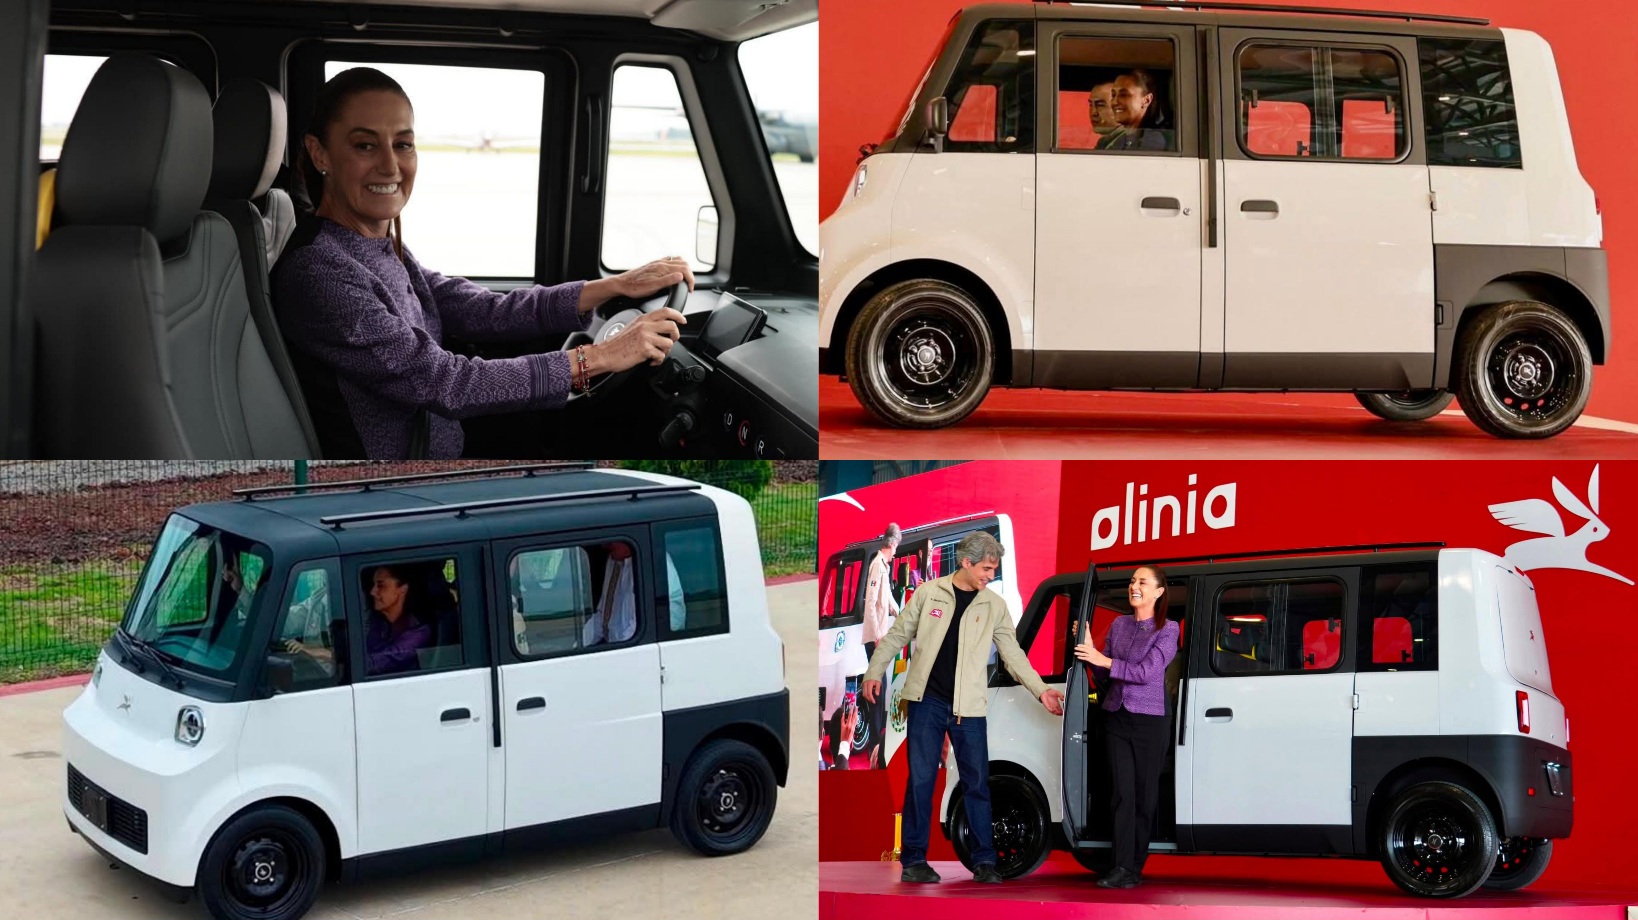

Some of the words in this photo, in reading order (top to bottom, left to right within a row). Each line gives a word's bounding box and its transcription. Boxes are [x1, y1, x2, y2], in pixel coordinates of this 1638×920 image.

[726, 413, 733, 426] D
[741, 426, 748, 440] N
[758, 440, 765, 455] R
[1090, 473, 1237, 551] alinia
